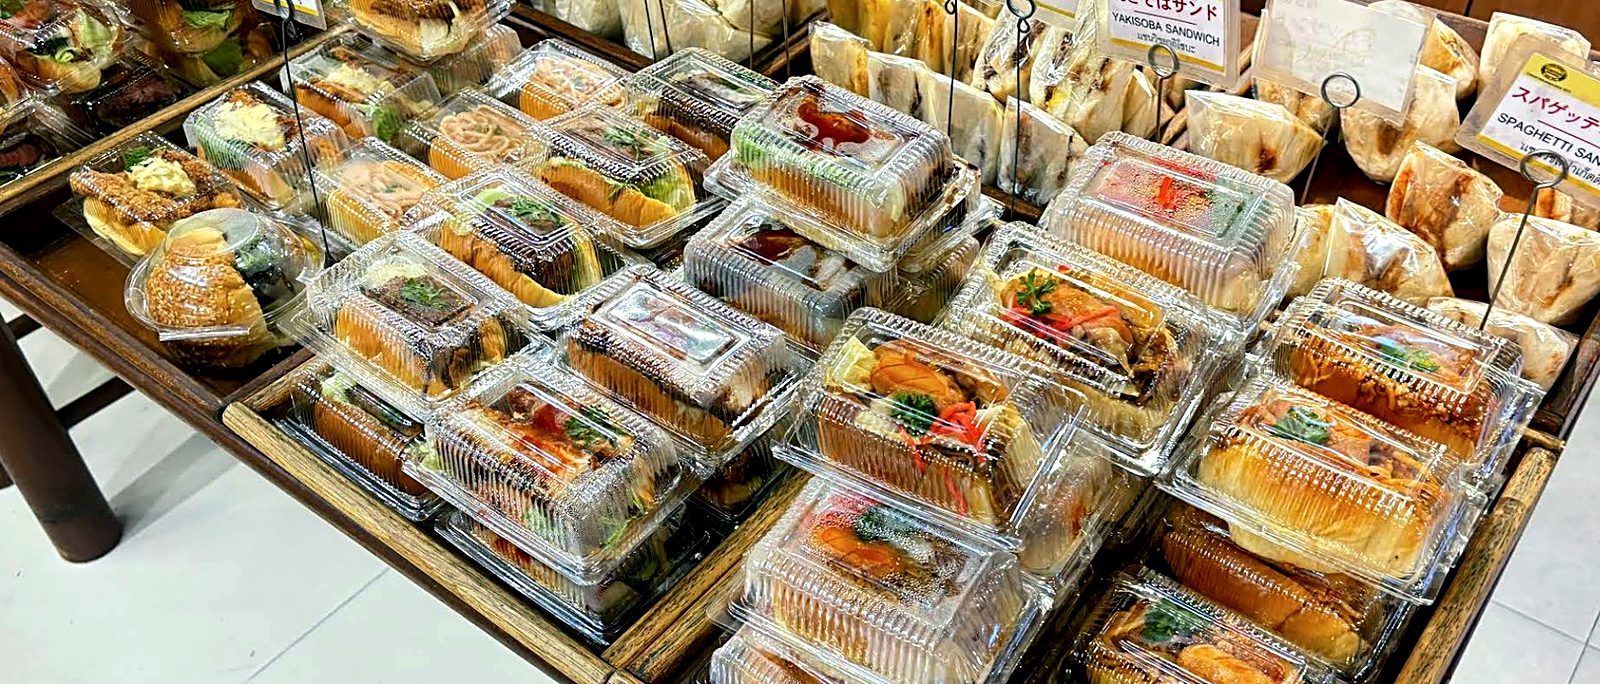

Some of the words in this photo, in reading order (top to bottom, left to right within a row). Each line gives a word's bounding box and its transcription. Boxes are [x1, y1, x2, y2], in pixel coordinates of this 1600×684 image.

[1112, 12, 1163, 32] YAKISOBA
[1165, 23, 1220, 47] SANDWICH
[1512, 86, 1600, 133] スパゲッテ
[1497, 112, 1574, 153] SPAGHETTI
